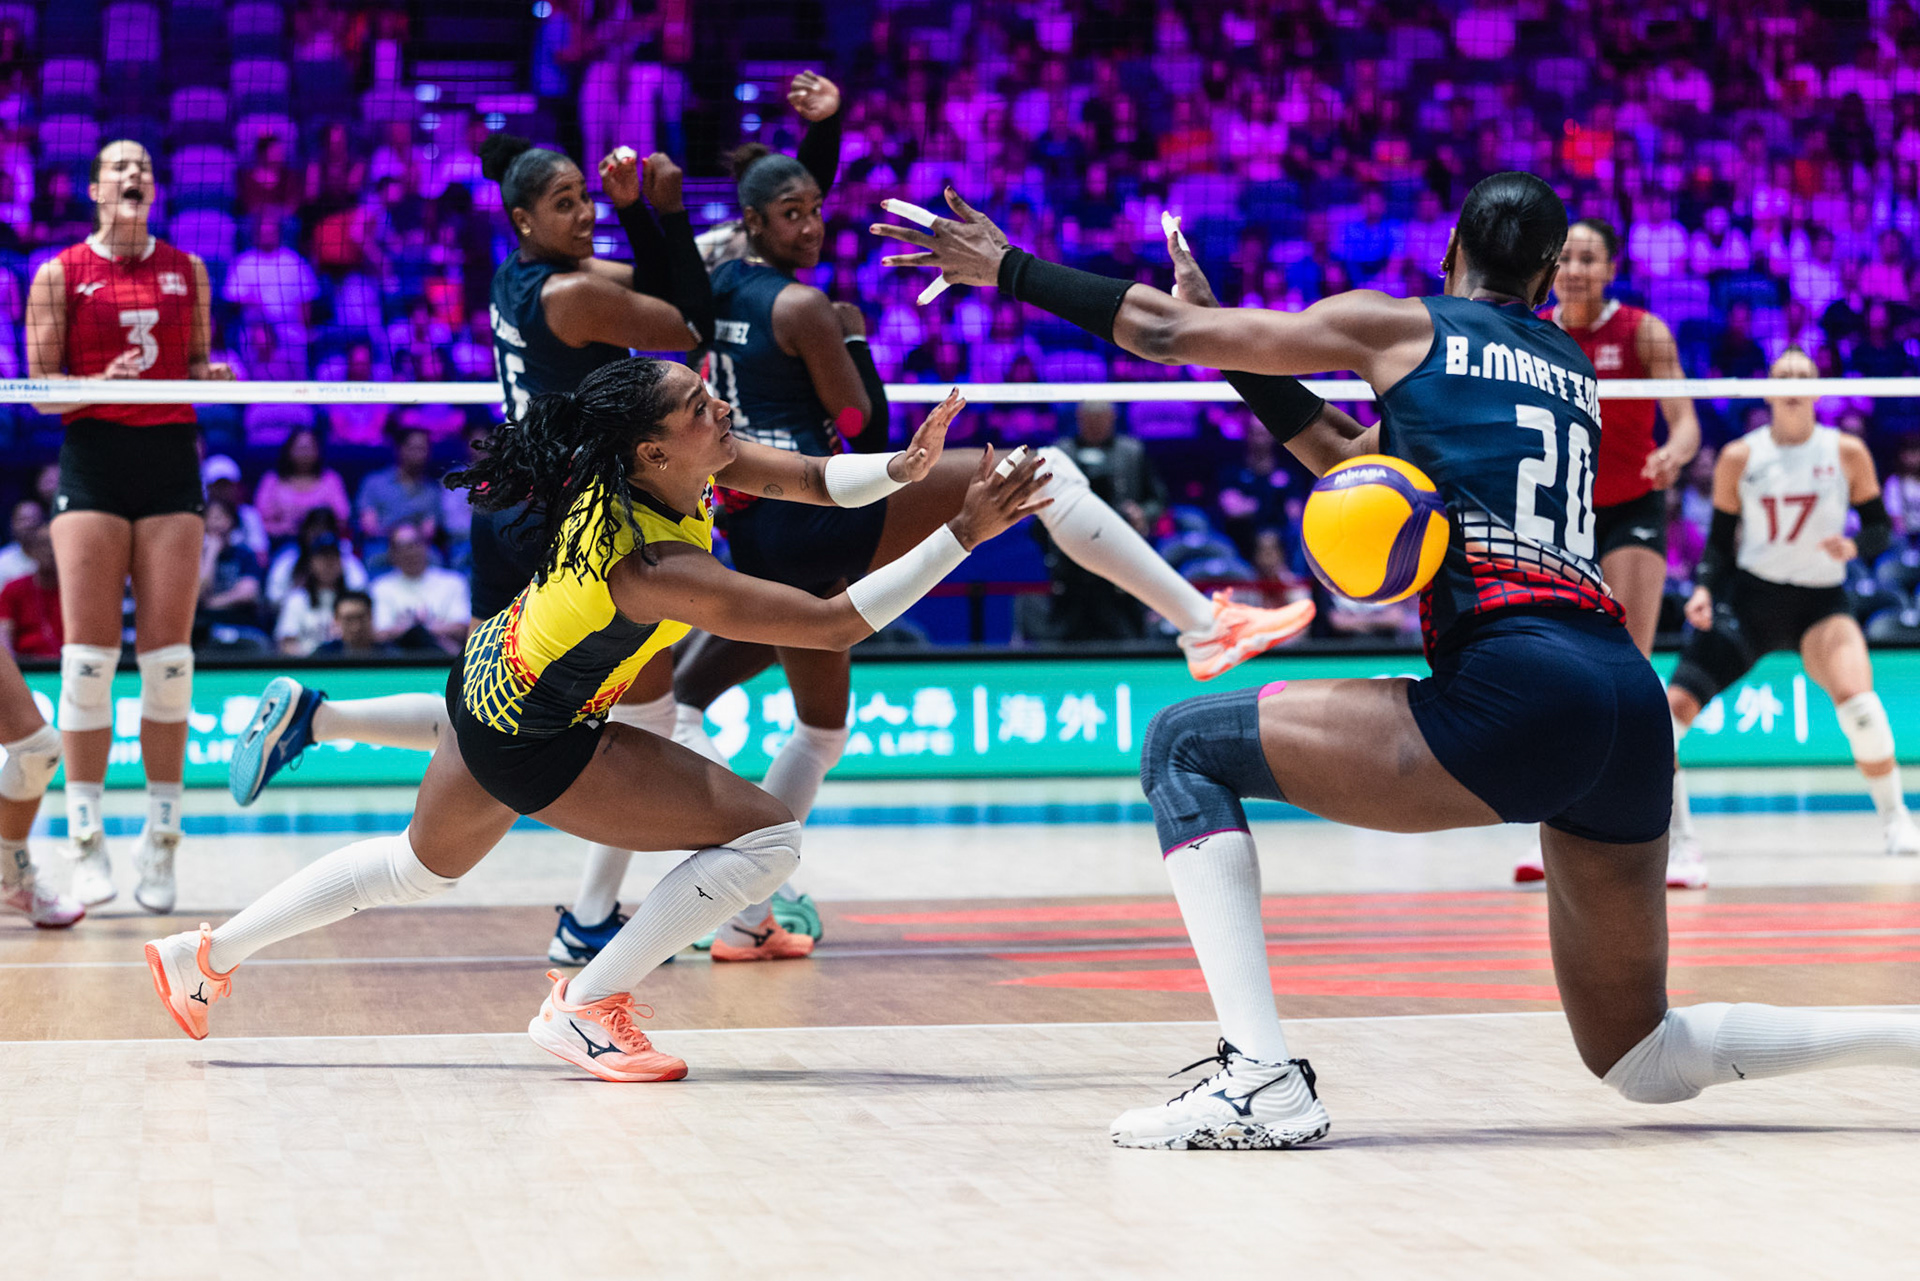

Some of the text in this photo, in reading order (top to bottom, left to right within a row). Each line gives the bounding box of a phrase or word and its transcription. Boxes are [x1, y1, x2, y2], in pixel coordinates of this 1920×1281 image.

[118, 308, 160, 372] 3
[1513, 404, 1597, 561] 20
[1760, 493, 1819, 544] 17
